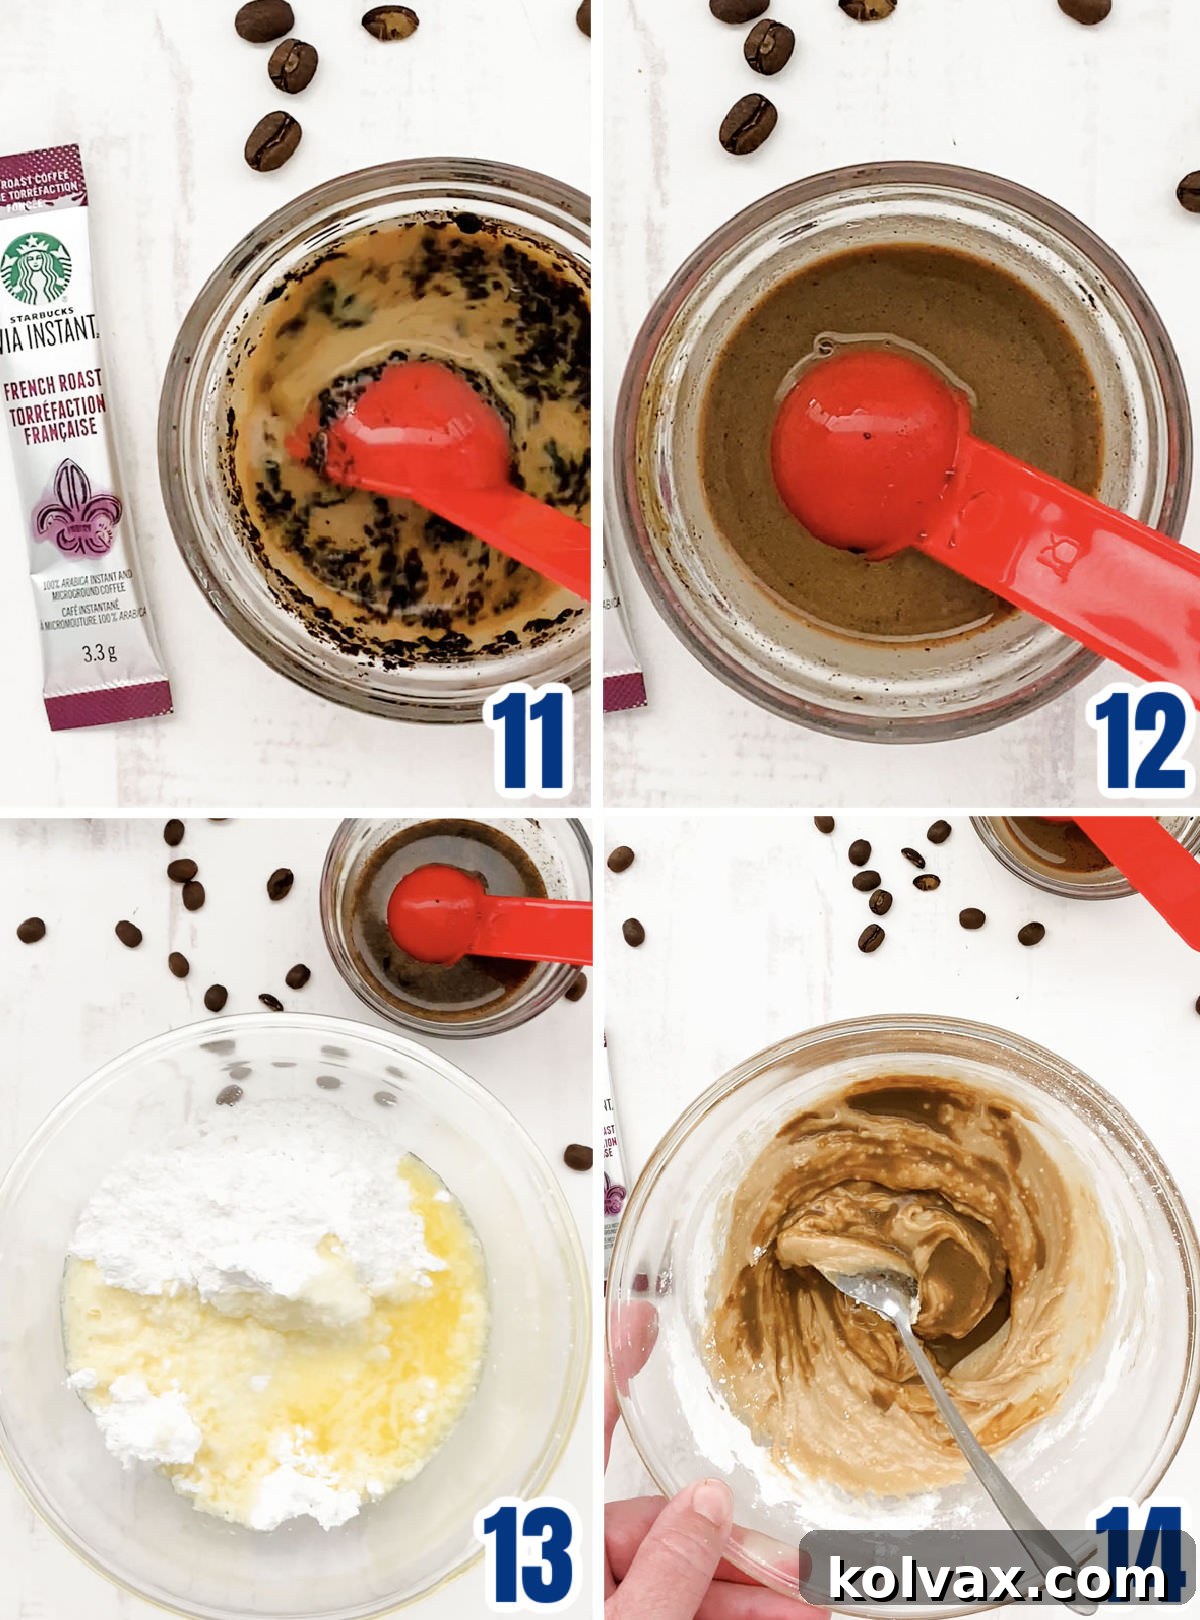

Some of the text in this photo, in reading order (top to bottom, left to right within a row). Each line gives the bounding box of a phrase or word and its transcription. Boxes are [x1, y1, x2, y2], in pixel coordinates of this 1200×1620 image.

[1, 168, 70, 190] ROAST COFFEE
[10, 306, 74, 324] STARBUCKS
[3, 368, 103, 402] FRENCH ROAST
[9, 393, 107, 428] TORRÉFACTION
[24, 417, 98, 446] FRANÇAISE
[90, 571, 117, 585] INSTANT
[118, 569, 133, 580] AND
[100, 582, 126, 595] COFFEE
[61, 604, 79, 617] CAFÉ
[119, 606, 147, 621] ARABCA
[82, 643, 118, 663] 3.3 g
